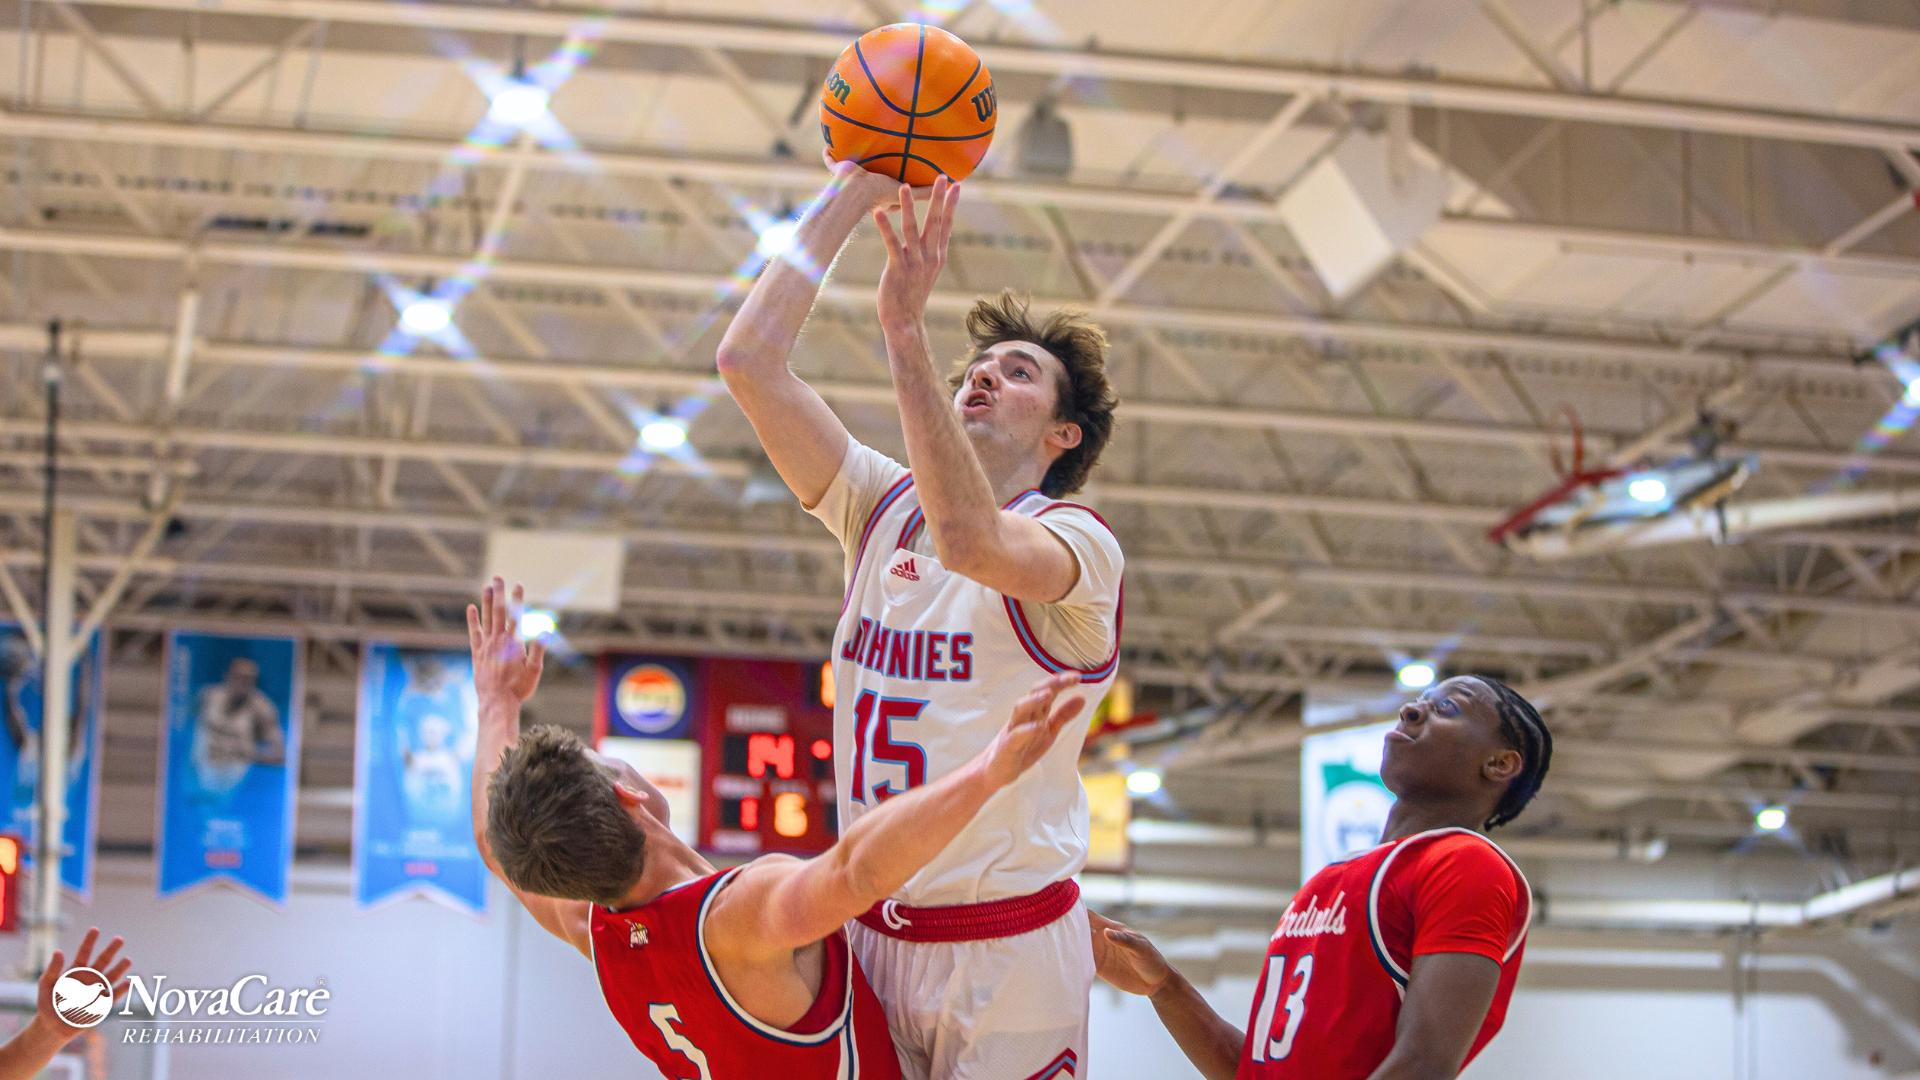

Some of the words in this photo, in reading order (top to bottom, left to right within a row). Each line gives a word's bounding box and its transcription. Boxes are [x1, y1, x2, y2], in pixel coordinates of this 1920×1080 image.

[851, 688, 931, 806] 15
[647, 1002, 713, 1080] 5
[1251, 952, 1314, 1063] 13
